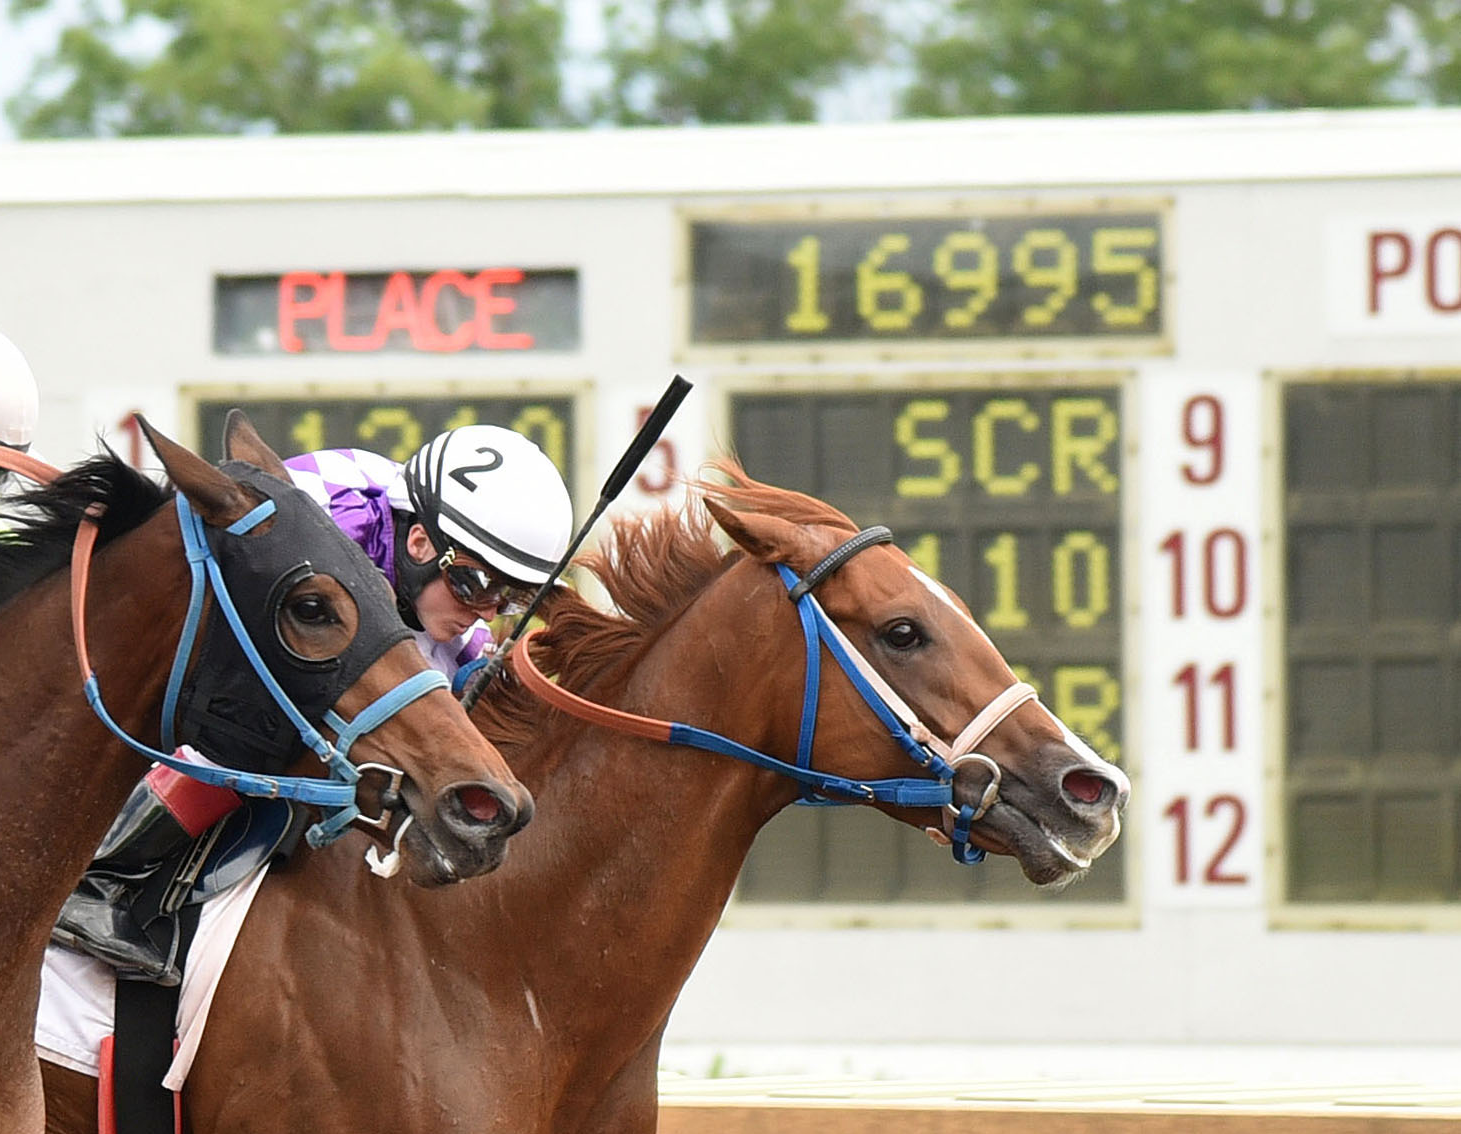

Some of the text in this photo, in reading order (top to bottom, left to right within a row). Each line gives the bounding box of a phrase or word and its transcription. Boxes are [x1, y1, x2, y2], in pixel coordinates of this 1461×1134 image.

[277, 268, 534, 352] PLACE
[784, 228, 1160, 333] 16995
[1367, 229, 1461, 314] PO
[291, 406, 566, 482] 120
[448, 446, 504, 493] 2
[895, 399, 1120, 496] SCR
[1180, 394, 1224, 486] 9
[1158, 527, 1249, 619] 10
[1173, 663, 1237, 752] 11
[1163, 796, 1249, 886] 12
